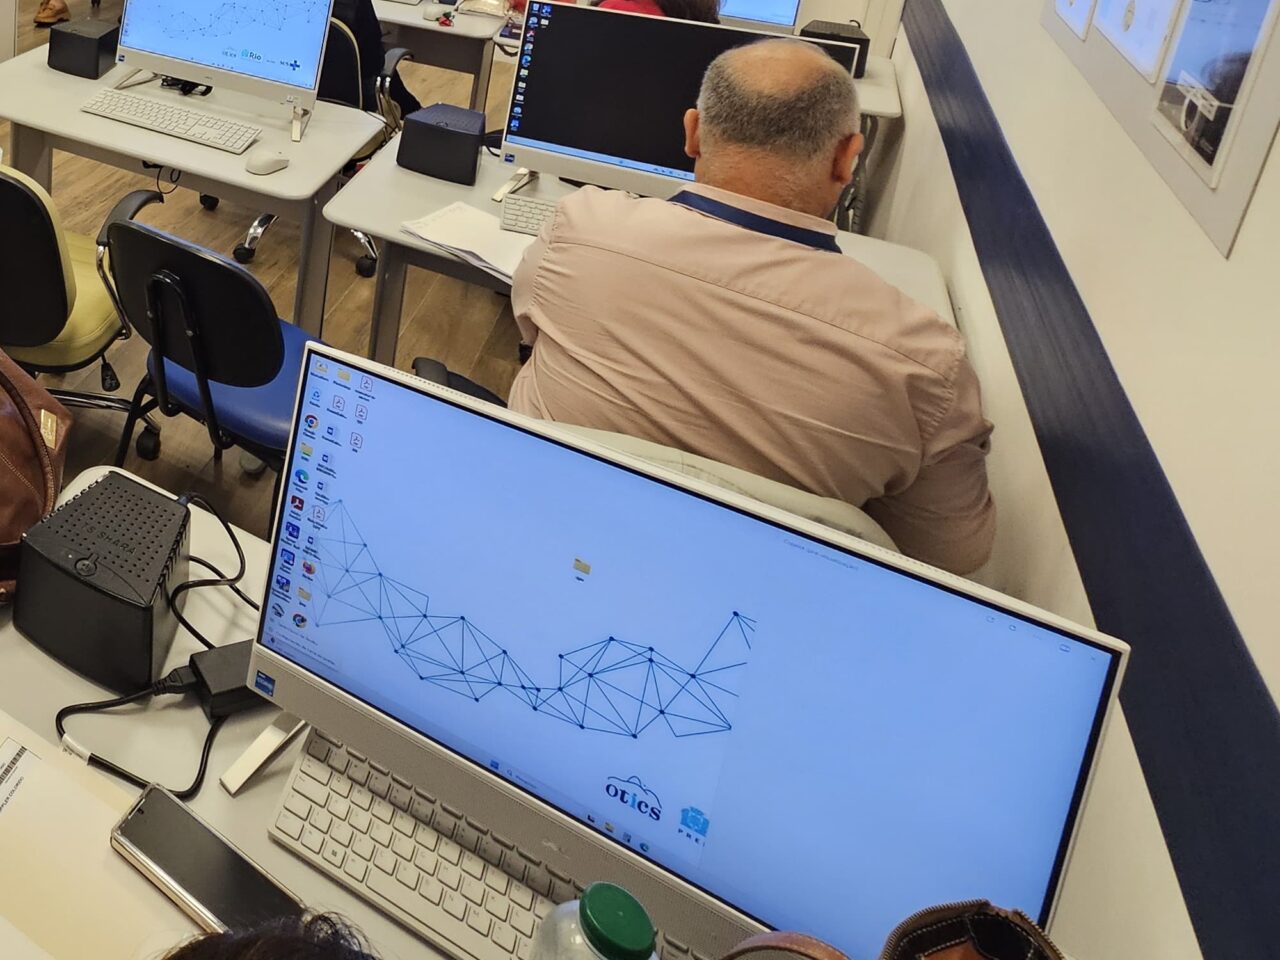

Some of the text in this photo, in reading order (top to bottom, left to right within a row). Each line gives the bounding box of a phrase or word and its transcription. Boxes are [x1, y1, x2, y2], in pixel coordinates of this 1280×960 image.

[249, 51, 262, 60] Rio
[82, 521, 137, 555] TS SHARA
[605, 783, 662, 822] otics
